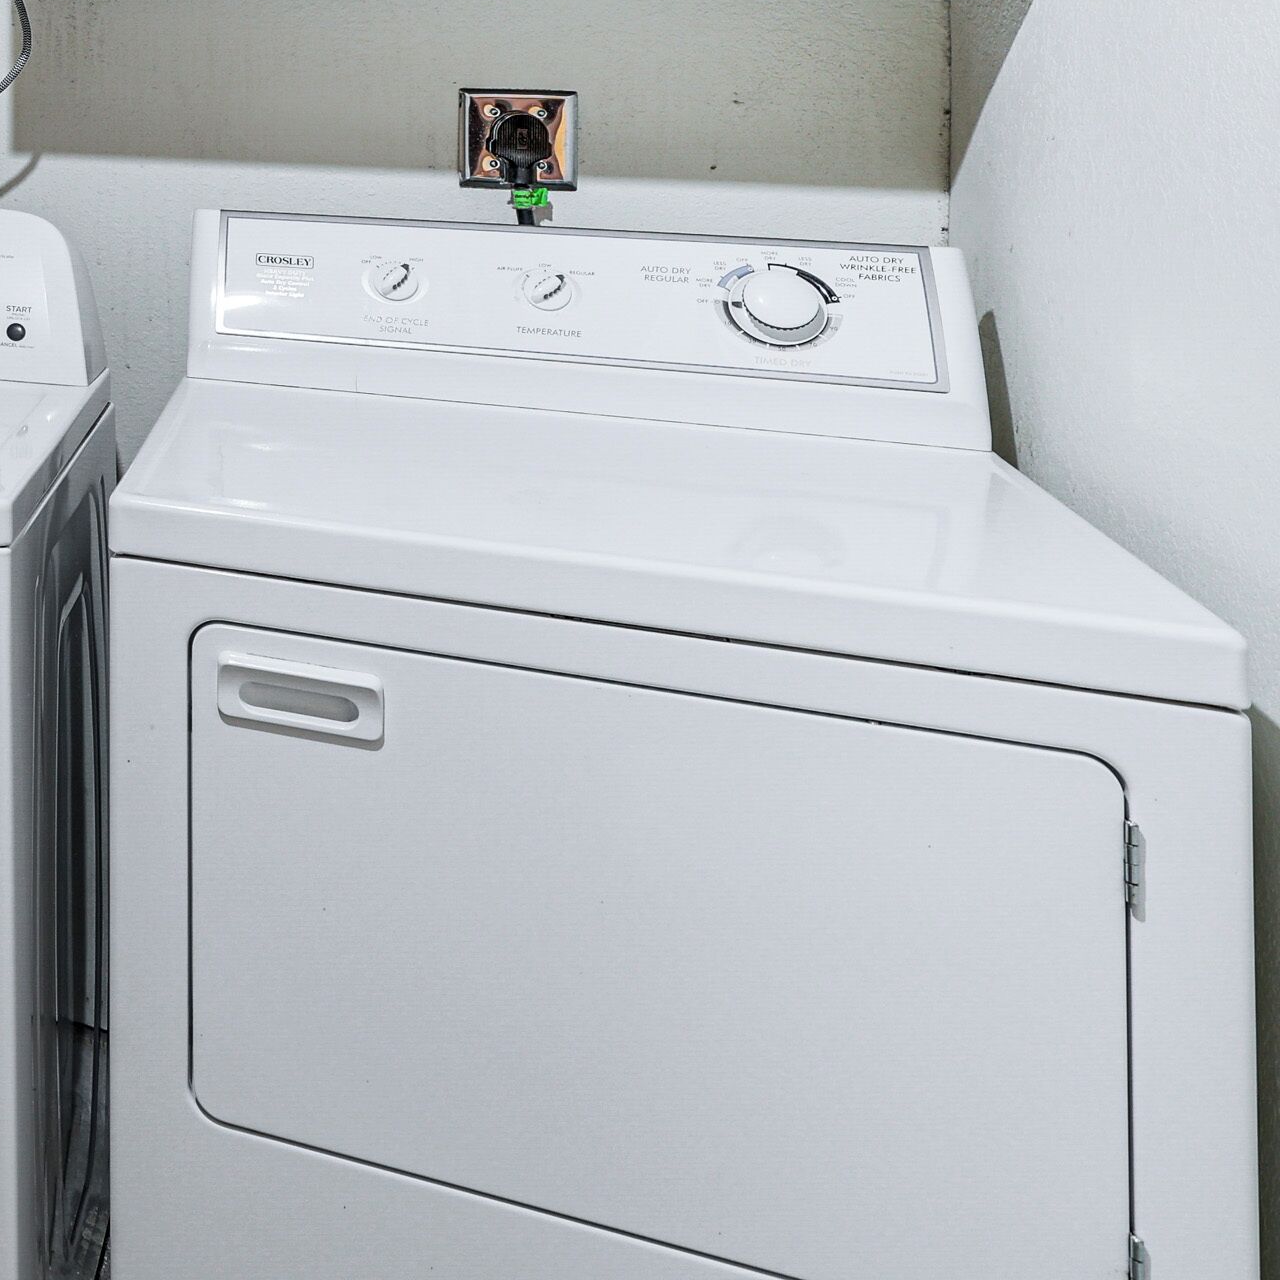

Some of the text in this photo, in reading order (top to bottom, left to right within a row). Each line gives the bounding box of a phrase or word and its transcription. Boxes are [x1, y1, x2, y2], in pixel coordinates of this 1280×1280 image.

[258, 255, 312, 266] CROSLEY
[849, 255, 904, 265] AUTO DRY
[640, 265, 691, 275] AUTO DRY
[840, 263, 917, 274] WRINKLE-FREE
[644, 274, 689, 283] REGULAR
[858, 273, 901, 283] FABRICS
[6, 305, 32, 314] START
[401, 318, 429, 327] CYCLE
[379, 326, 412, 335] SIGNAL
[516, 326, 582, 337] TEMPERATURE
[754, 356, 812, 368] TIMED DRY
